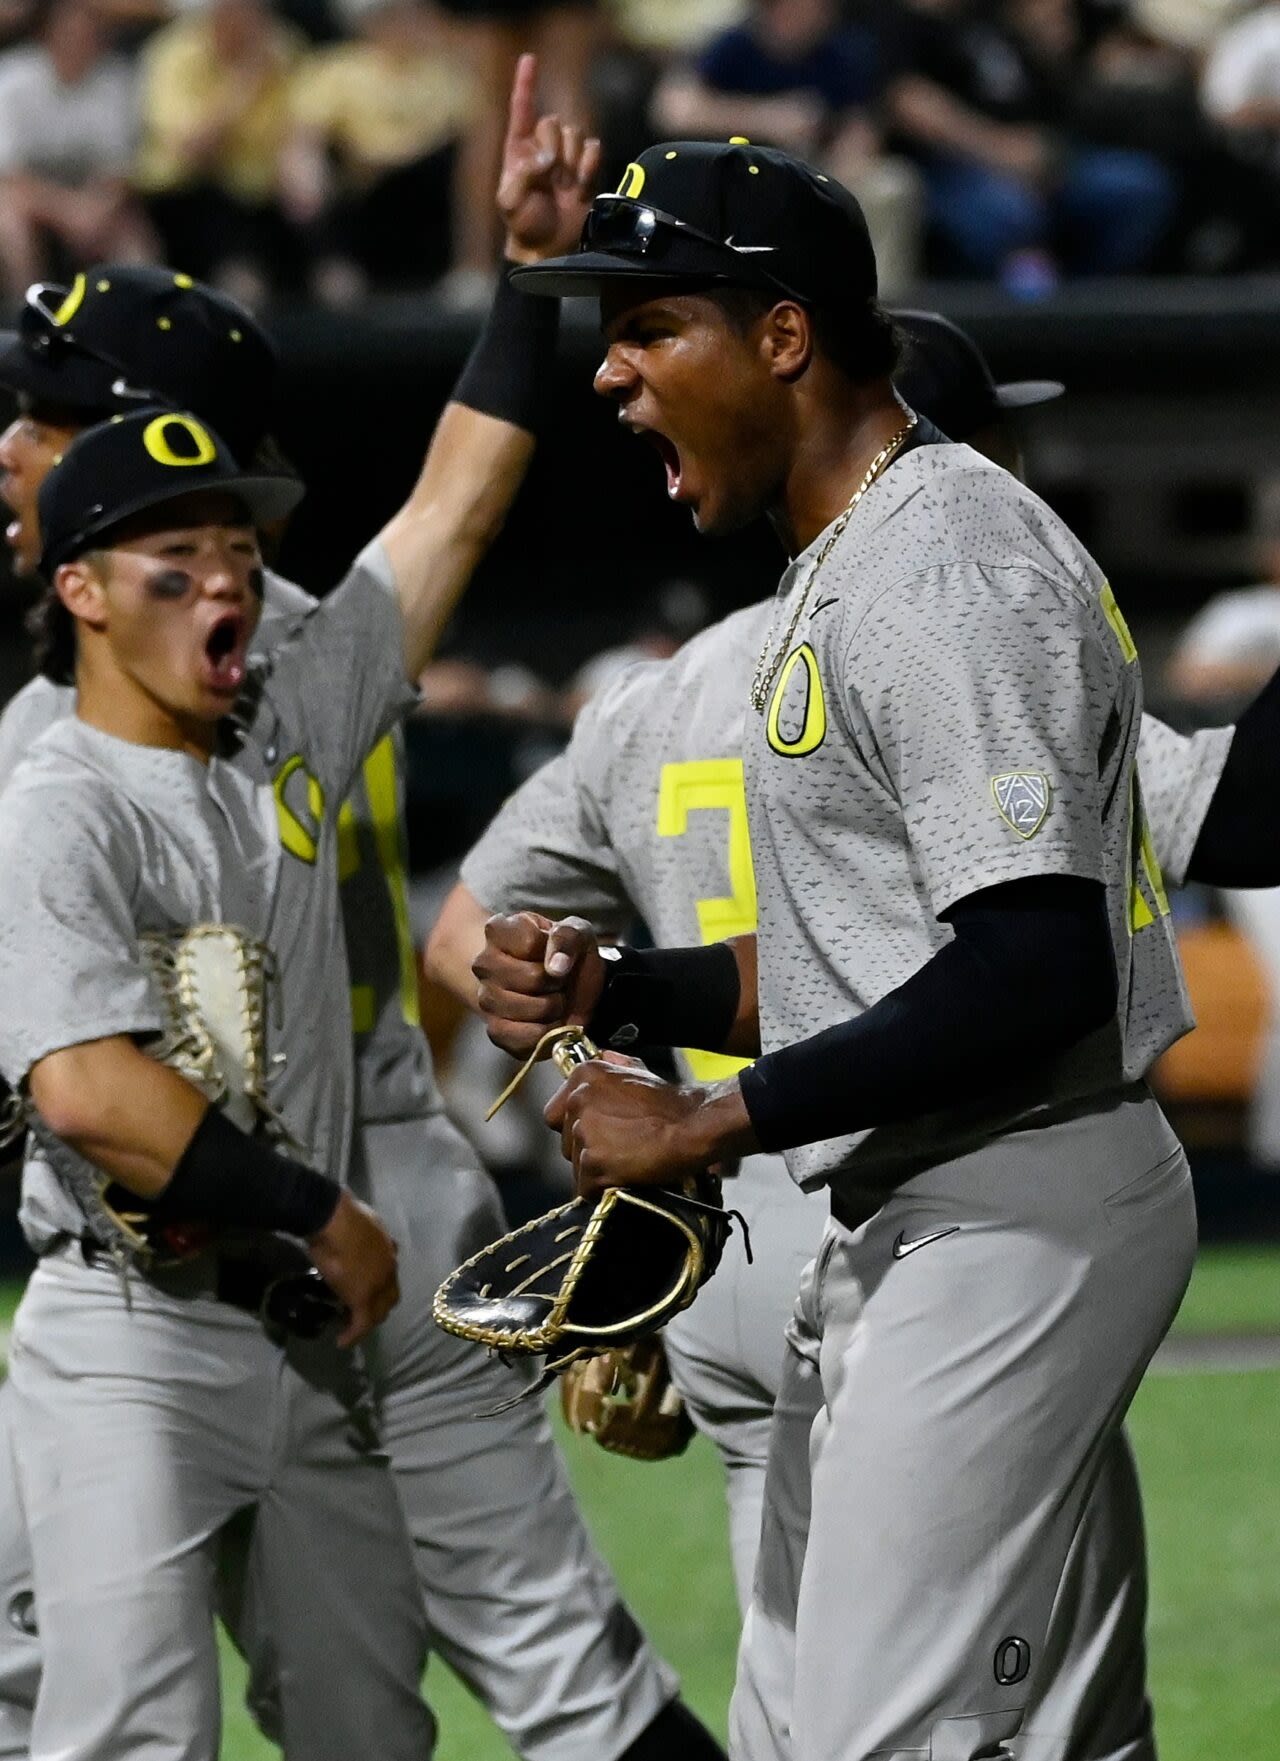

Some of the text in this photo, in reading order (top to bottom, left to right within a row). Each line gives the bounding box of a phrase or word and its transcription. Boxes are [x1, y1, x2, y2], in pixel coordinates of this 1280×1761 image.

[143, 412, 217, 467] O
[766, 640, 827, 759] O
[1009, 798, 1040, 825] 12
[993, 1635, 1031, 1687] O
